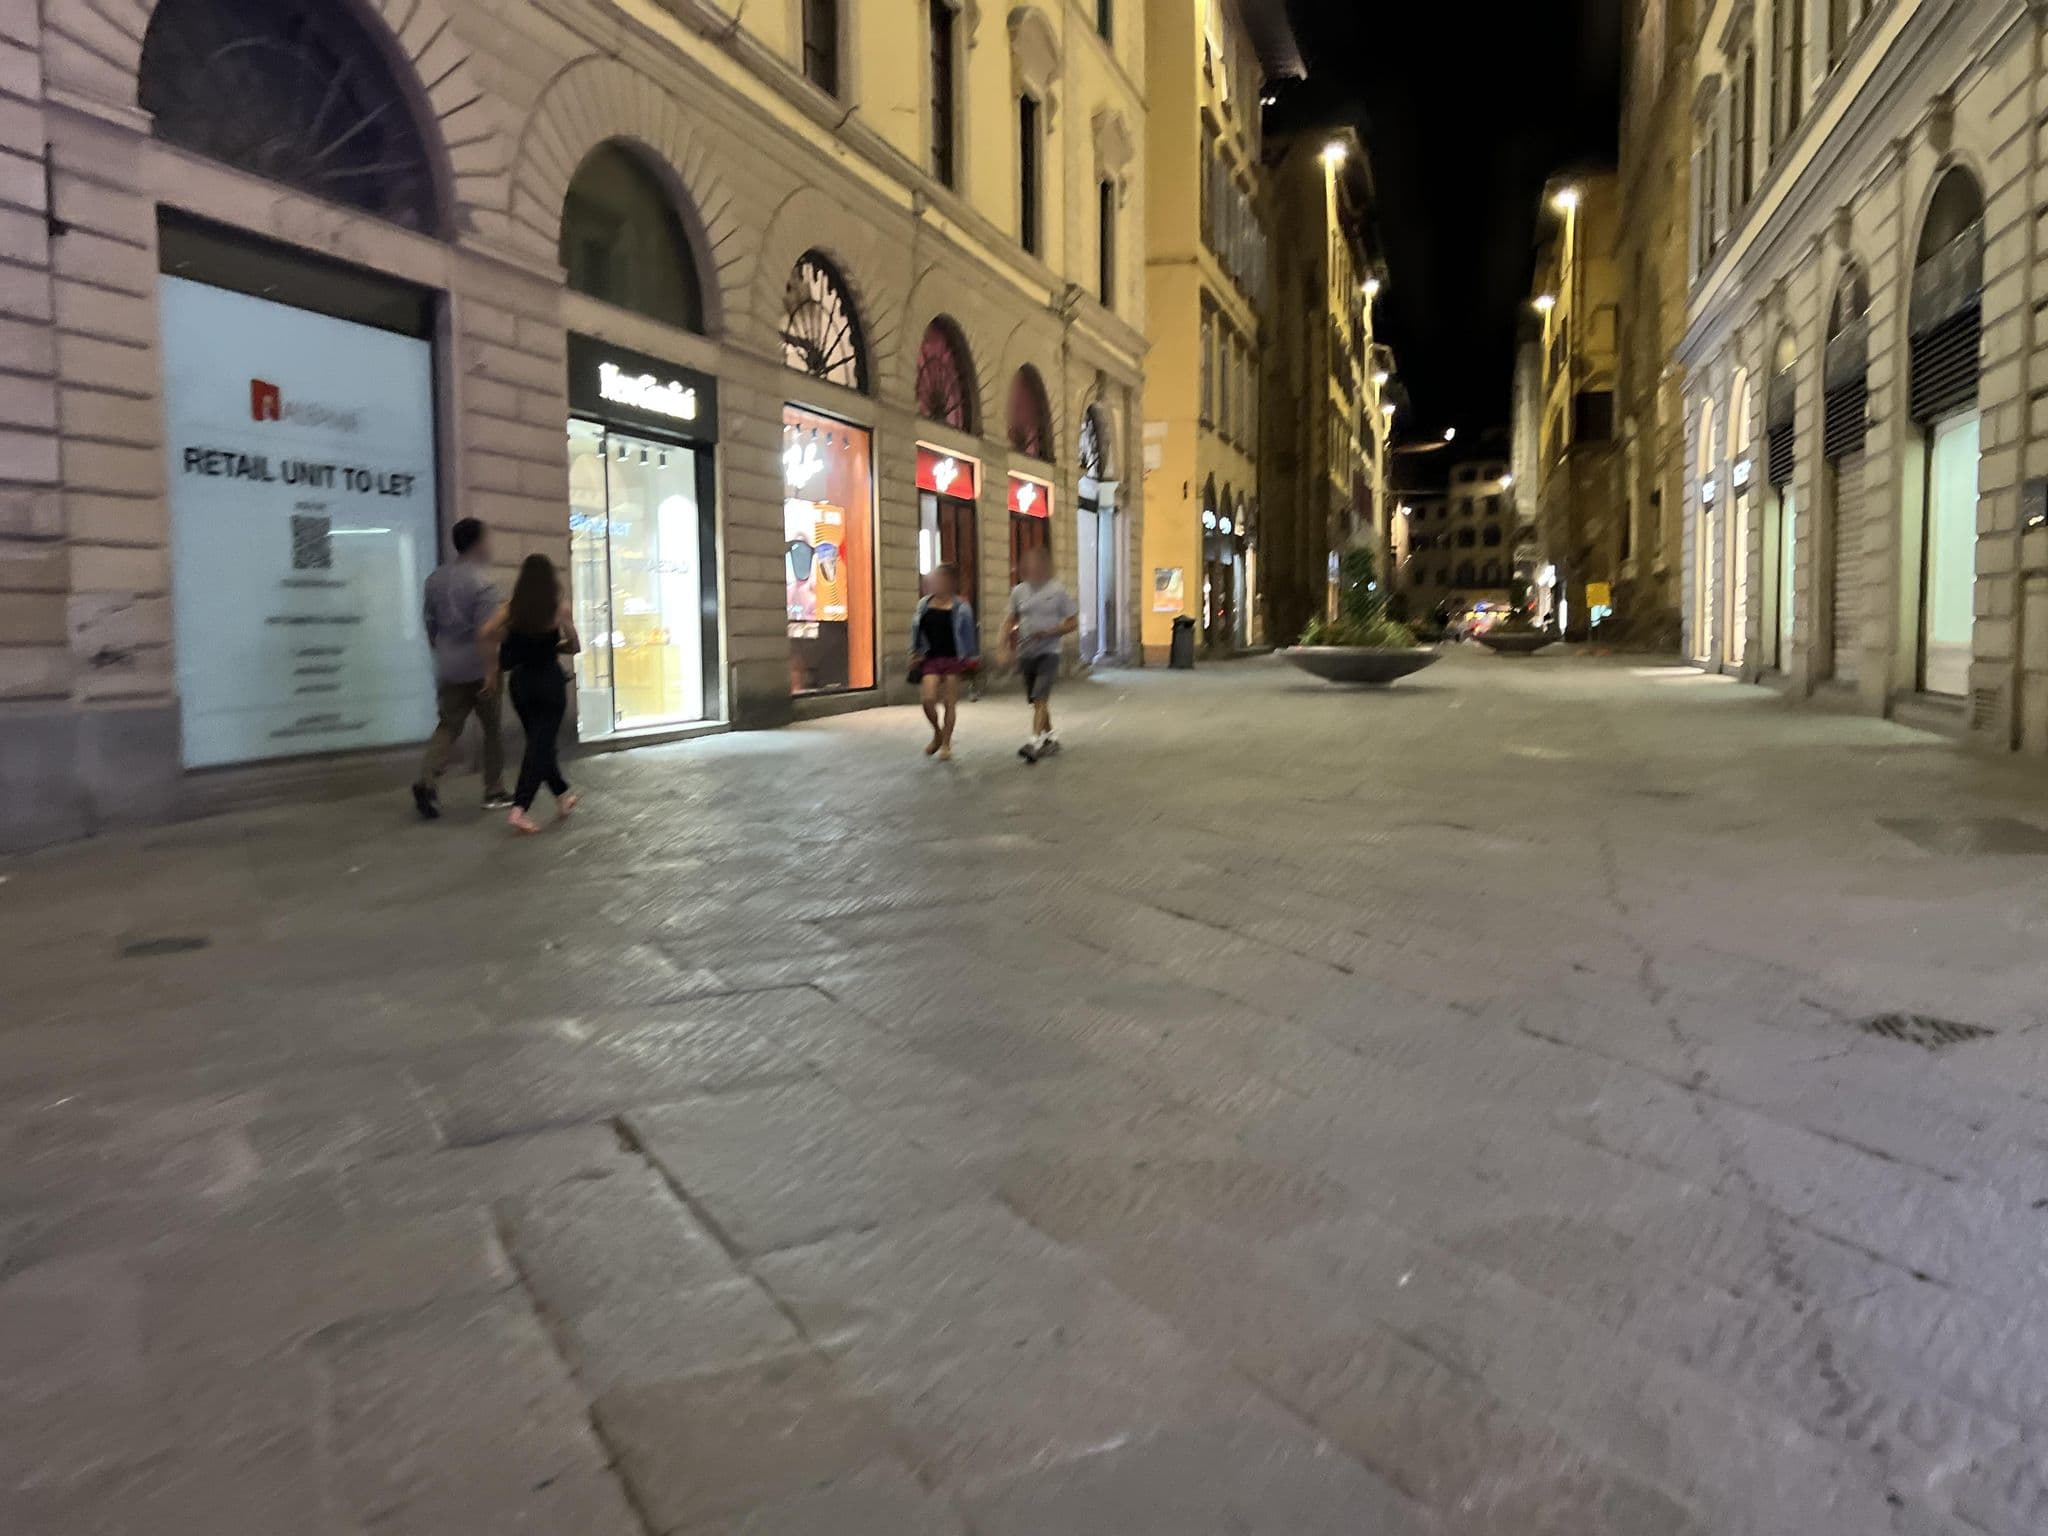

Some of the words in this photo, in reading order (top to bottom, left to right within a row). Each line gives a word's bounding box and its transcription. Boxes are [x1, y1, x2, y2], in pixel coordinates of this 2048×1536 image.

[184, 447, 276, 482] RETAIL
[281, 460, 336, 488] UNIT
[343, 467, 371, 494] TO
[378, 473, 415, 497] LET
